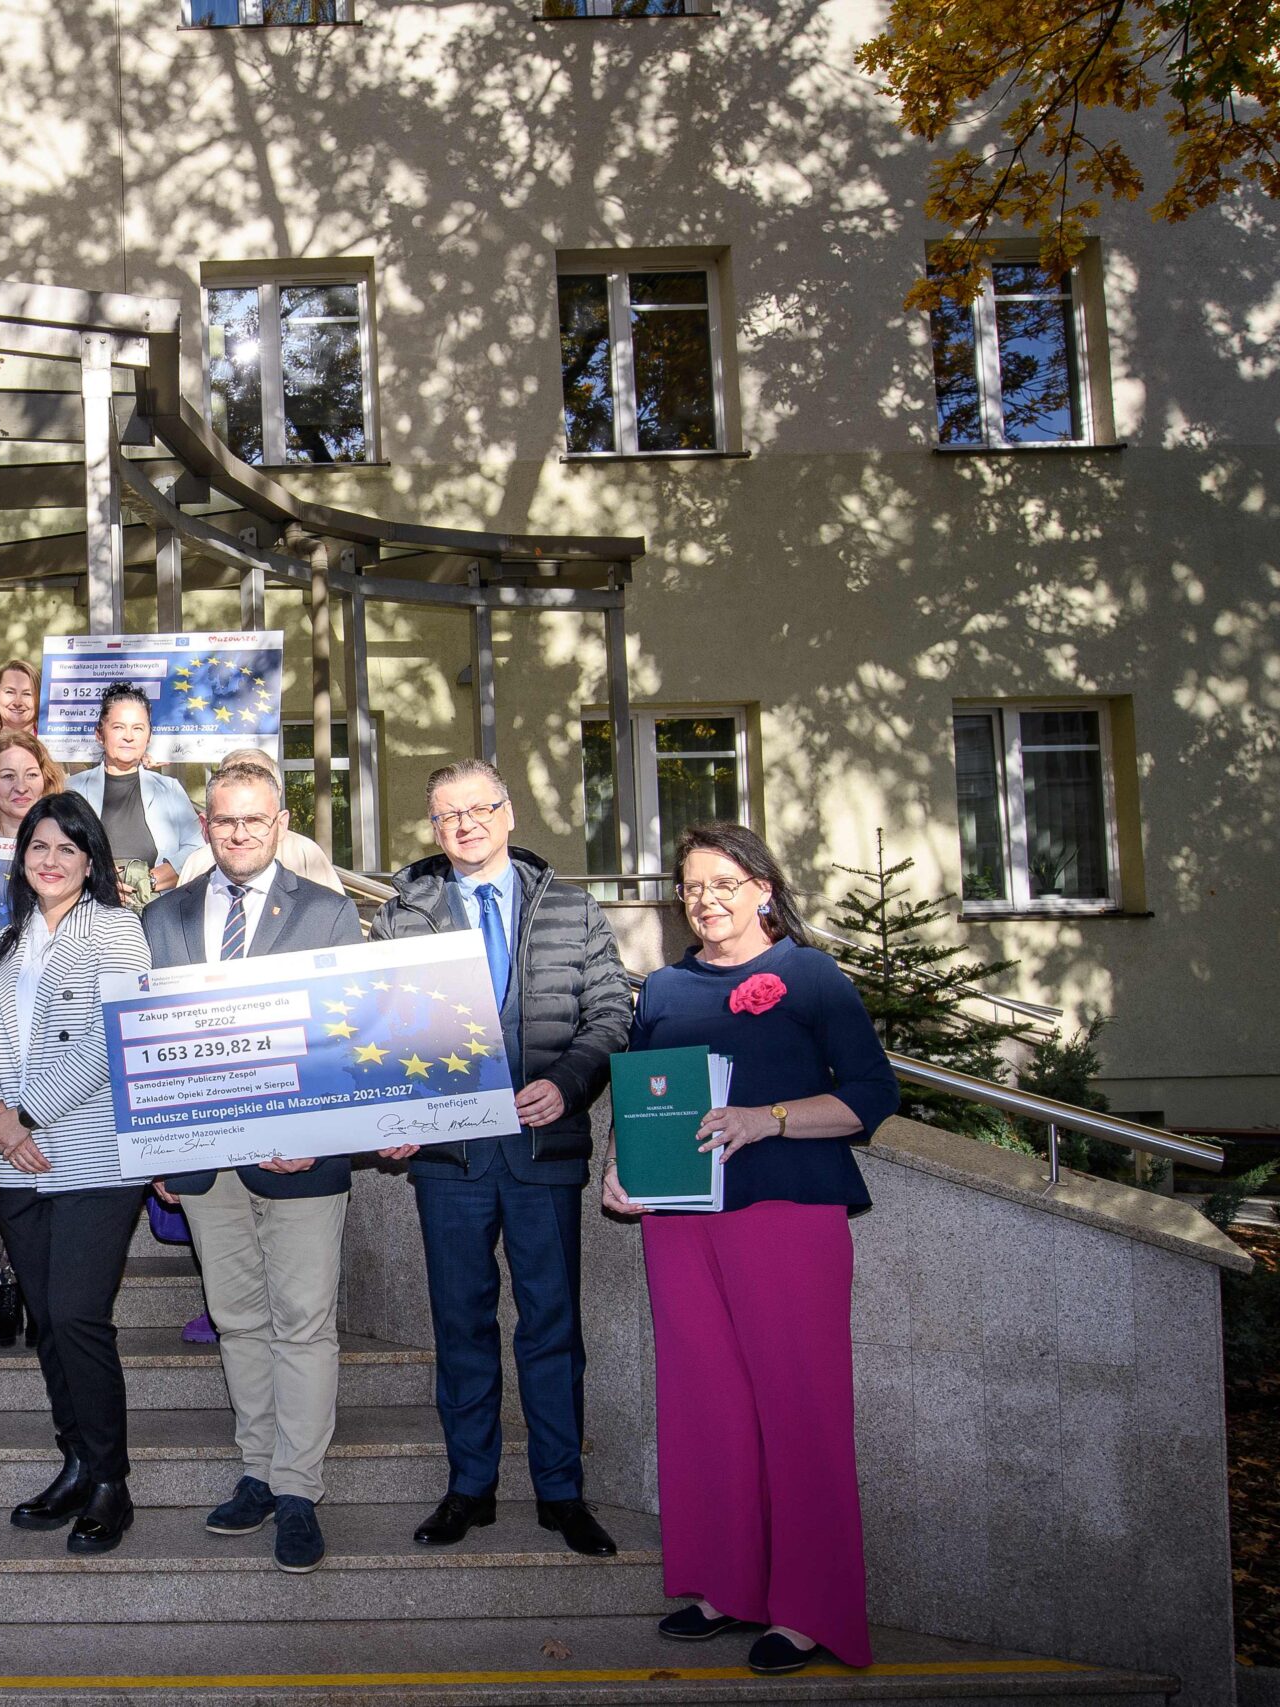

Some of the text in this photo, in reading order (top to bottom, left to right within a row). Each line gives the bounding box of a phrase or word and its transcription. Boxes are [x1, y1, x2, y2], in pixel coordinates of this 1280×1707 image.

[120, 662, 160, 670] zabytkowych
[63, 688, 107, 697] 9 152 22
[60, 708, 100, 718] Powiat Ży
[180, 724, 219, 732] 2021-2027
[138, 998, 290, 1022] Zakup sprzętu medycznego dla
[194, 1016, 236, 1028] SPZZOZ
[142, 1036, 271, 1064] 1 653 239,82 zł
[134, 1069, 257, 1090] Samodzielny Publiczny Zespół
[136, 1094, 175, 1104] Zakładów
[178, 1090, 204, 1100] Opieki
[206, 1084, 253, 1096] Zdrowotnej
[264, 1079, 295, 1090] Sierpcu
[131, 1084, 414, 1126] Fundusze Europejskie dla Mazowsza 2021-2027
[131, 1132, 190, 1145] Województwo
[192, 1126, 245, 1138] Mazowieckie
[427, 1097, 478, 1110] Beneficjent
